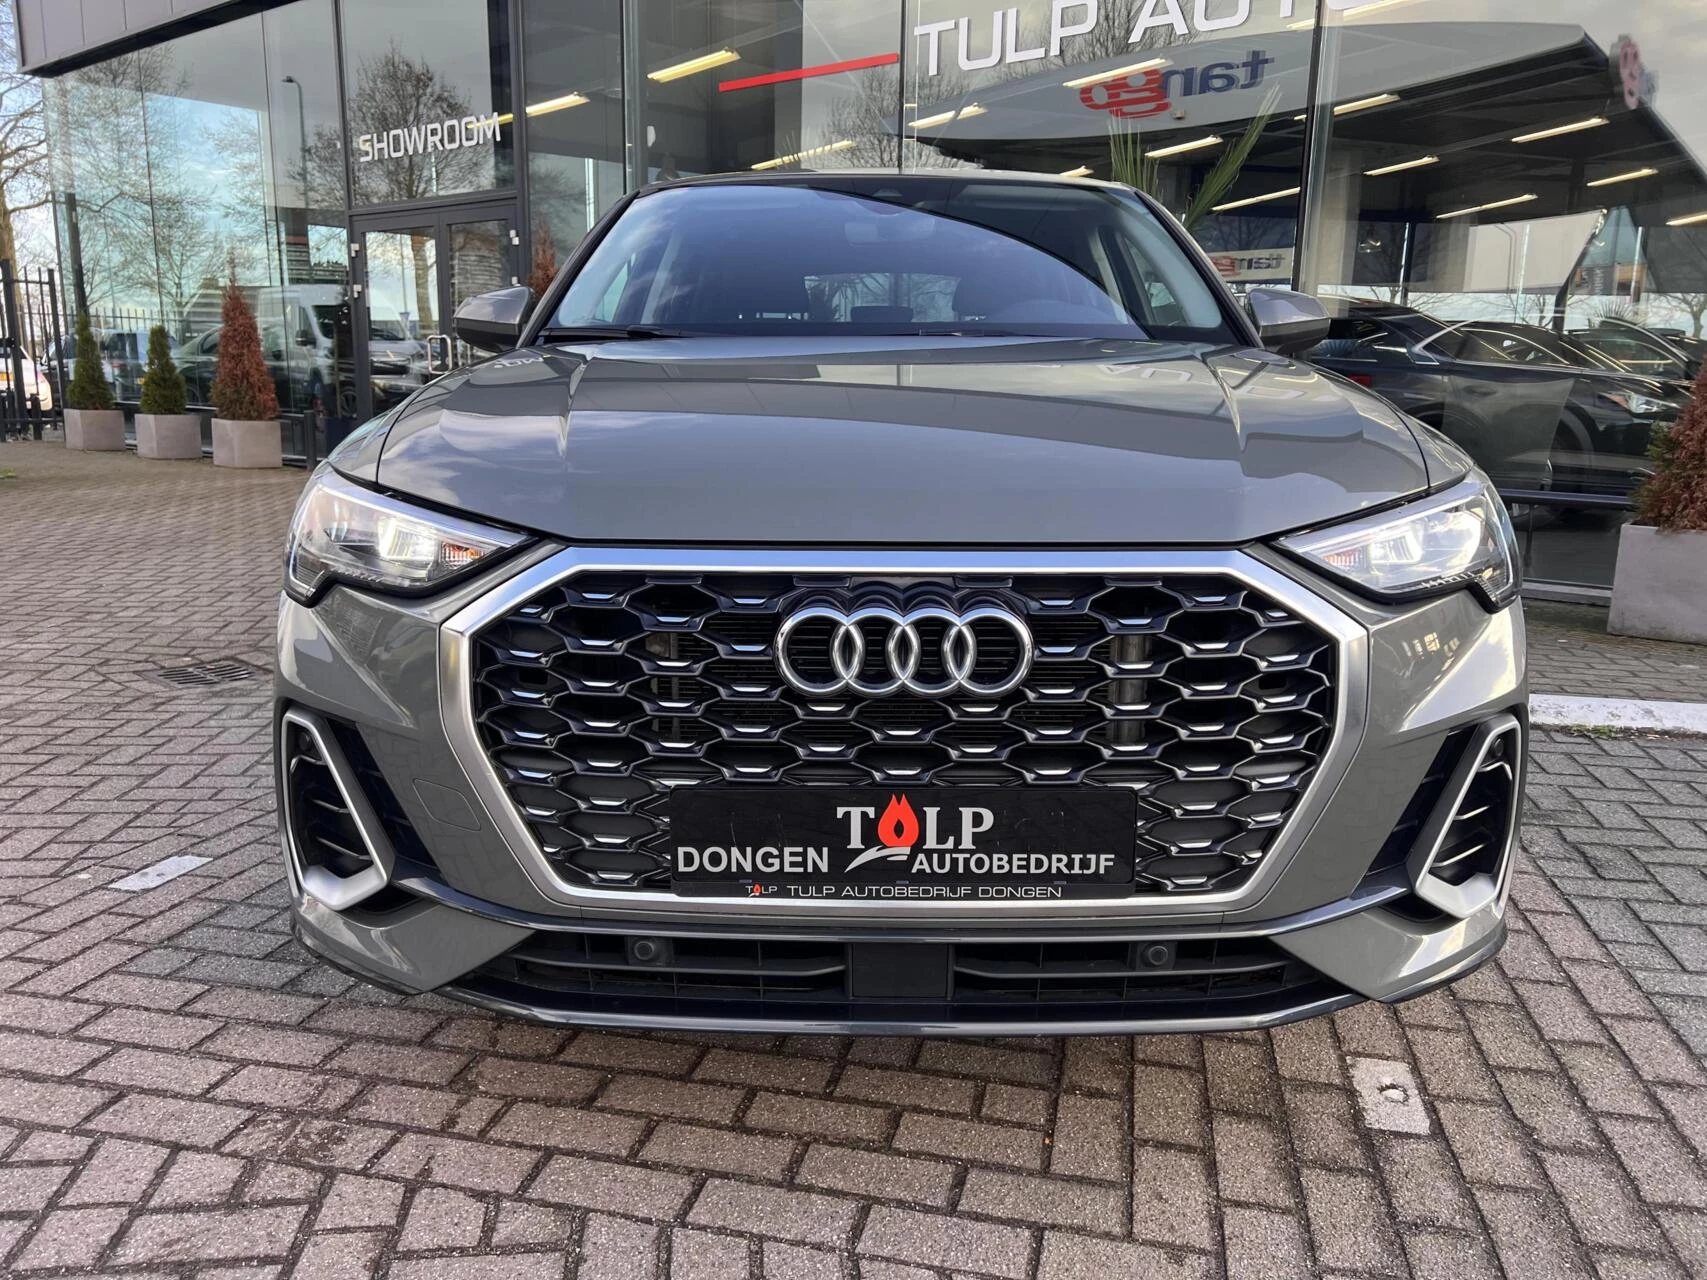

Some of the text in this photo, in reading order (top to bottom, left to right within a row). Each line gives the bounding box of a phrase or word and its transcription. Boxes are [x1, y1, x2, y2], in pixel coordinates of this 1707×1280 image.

[914, 0, 1098, 76] TULP
[359, 112, 501, 162] SHOWROOM
[677, 846, 829, 873] DONGEN
[911, 853, 1115, 874] AUTOBEDRIJF
[786, 885, 836, 897] TULP
[841, 885, 972, 898] AUTOBEDRIJF
[978, 886, 1062, 898] DONGEN
